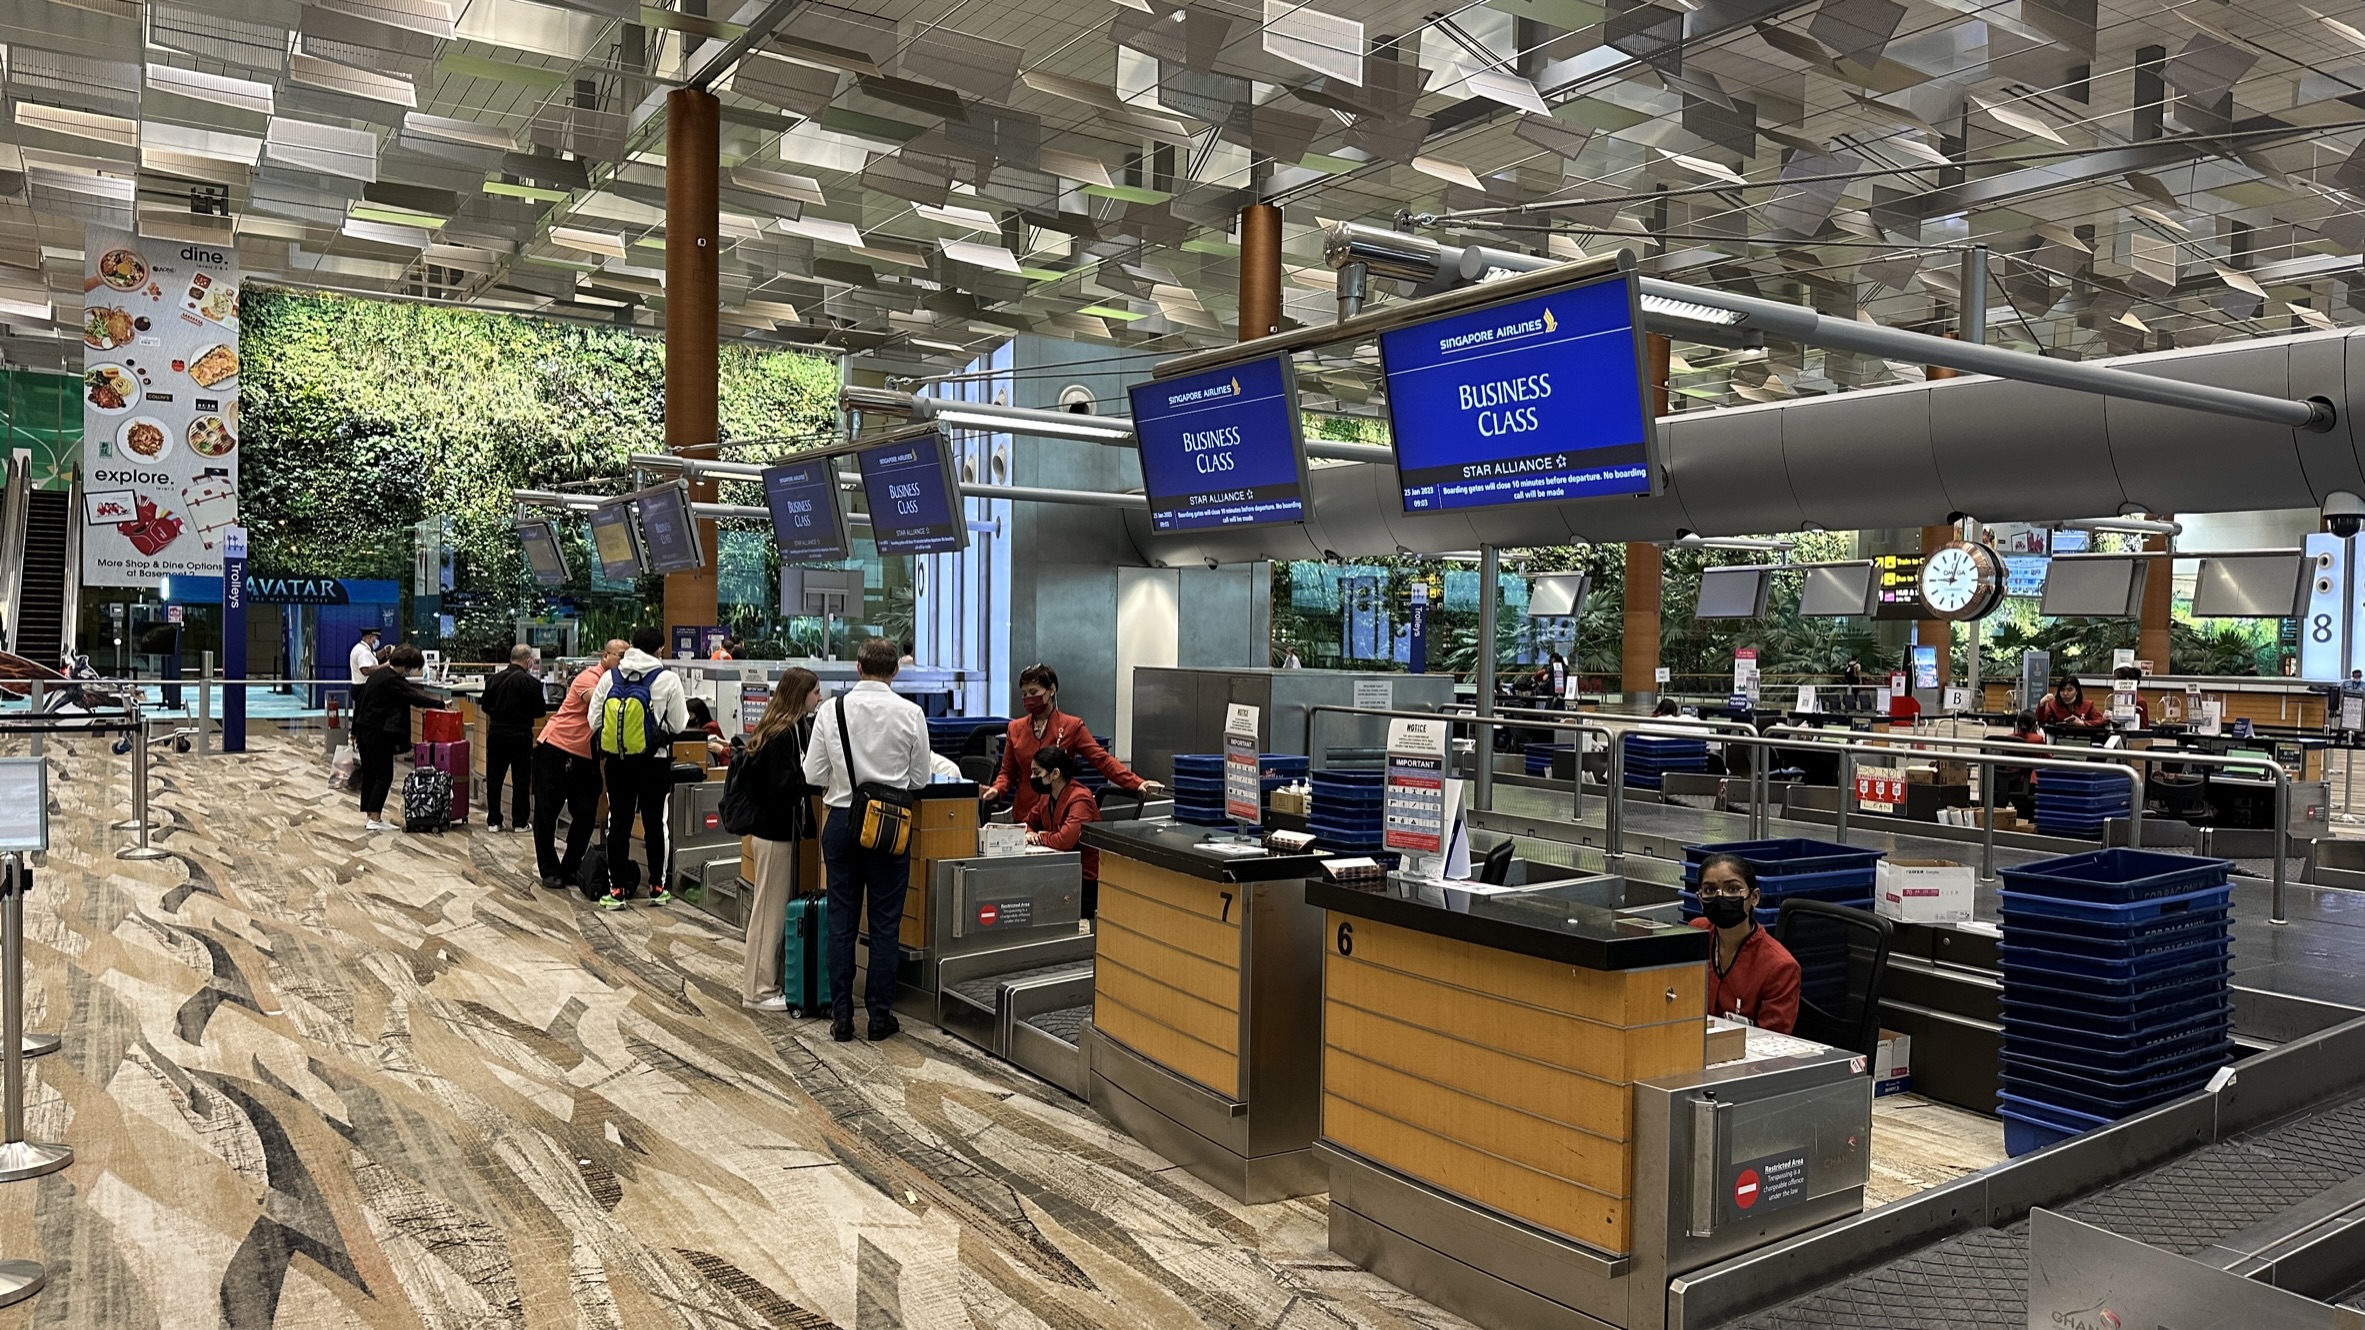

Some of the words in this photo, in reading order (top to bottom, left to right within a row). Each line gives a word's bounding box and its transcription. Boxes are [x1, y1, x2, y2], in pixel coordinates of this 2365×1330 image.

[181, 246, 228, 265] dine.
[1440, 329, 1493, 350] SINGAPORE
[1496, 319, 1542, 338] AIRLINES
[1168, 391, 1202, 405] SINGAPORE
[1203, 384, 1232, 398] AIRLINES
[1458, 373, 1552, 410] BUSINESS
[1477, 407, 1539, 437] CLASS
[1182, 426, 1241, 452] BUSINESS
[1196, 452, 1235, 474] CLASS
[1463, 464, 1492, 478] STAR
[1494, 457, 1552, 475] ALLIANCE
[95, 469, 174, 485] explore.
[1443, 485, 1468, 496] Boarding
[1468, 484, 1484, 495] gates
[1484, 482, 1496, 491] will
[1496, 480, 1511, 490] close
[1511, 479, 1520, 489] 10
[1520, 478, 1545, 488] minutes
[1545, 475, 1567, 487] before
[1567, 472, 1602, 486] departure.
[1603, 470, 1614, 480] No
[1614, 467, 1647, 479] boarding
[888, 482, 920, 499] BUSINESS
[1189, 496, 1207, 506] STAR
[1209, 490, 1245, 504] ALLIANCE
[1404, 489, 1411, 497] 25
[1411, 488, 1421, 496] Jan
[1513, 491, 1524, 501] call
[1524, 490, 1537, 499] will
[1537, 489, 1546, 498] be
[1546, 487, 1565, 497] made
[787, 499, 812, 514] BUSINESS
[897, 500, 918, 515] CLASS
[1282, 501, 1302, 510] boarding
[794, 514, 812, 528] CLASS
[97, 558, 123, 568] More
[125, 560, 150, 570] Shop
[162, 561, 184, 569] Dine
[186, 561, 223, 571] Options
[126, 569, 137, 577] at
[230, 562, 242, 609] Trolleys
[246, 575, 336, 597] AVATAR
[1413, 606, 1423, 638] Trolleys
[2312, 613, 2333, 643] 8
[1953, 692, 1962, 705] B
[1406, 723, 1427, 733] NOTICE
[1230, 738, 1253, 748] IMPORTANT
[1396, 759, 1435, 769] IMPORTANT
[1220, 891, 1233, 923] 7
[1337, 922, 1353, 957] 6
[1764, 1160, 1791, 1174] Restricted
[1791, 1158, 1804, 1167] Area
[1767, 1170, 1793, 1182] Trespassing
[1763, 1181, 1788, 1193] chargeable
[1788, 1177, 1804, 1187] offence
[1768, 1193, 1782, 1201] under
